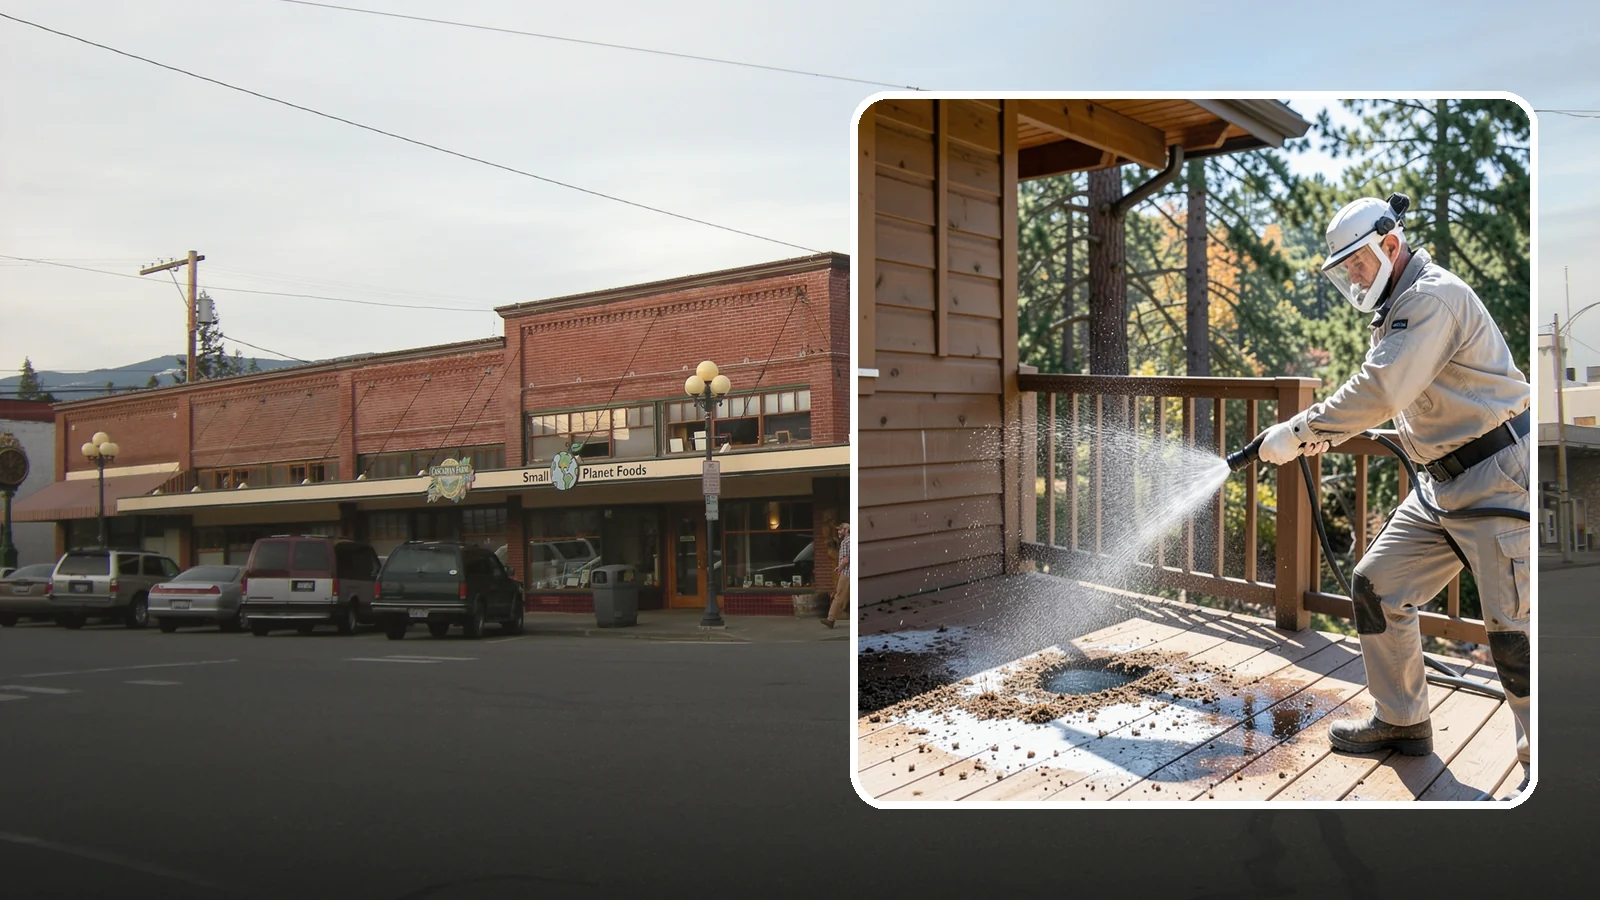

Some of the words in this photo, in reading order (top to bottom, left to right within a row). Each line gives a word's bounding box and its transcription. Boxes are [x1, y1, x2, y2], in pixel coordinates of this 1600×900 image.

[523, 470, 549, 483] Small
[582, 468, 614, 479] Planet
[616, 464, 647, 477] Foods
